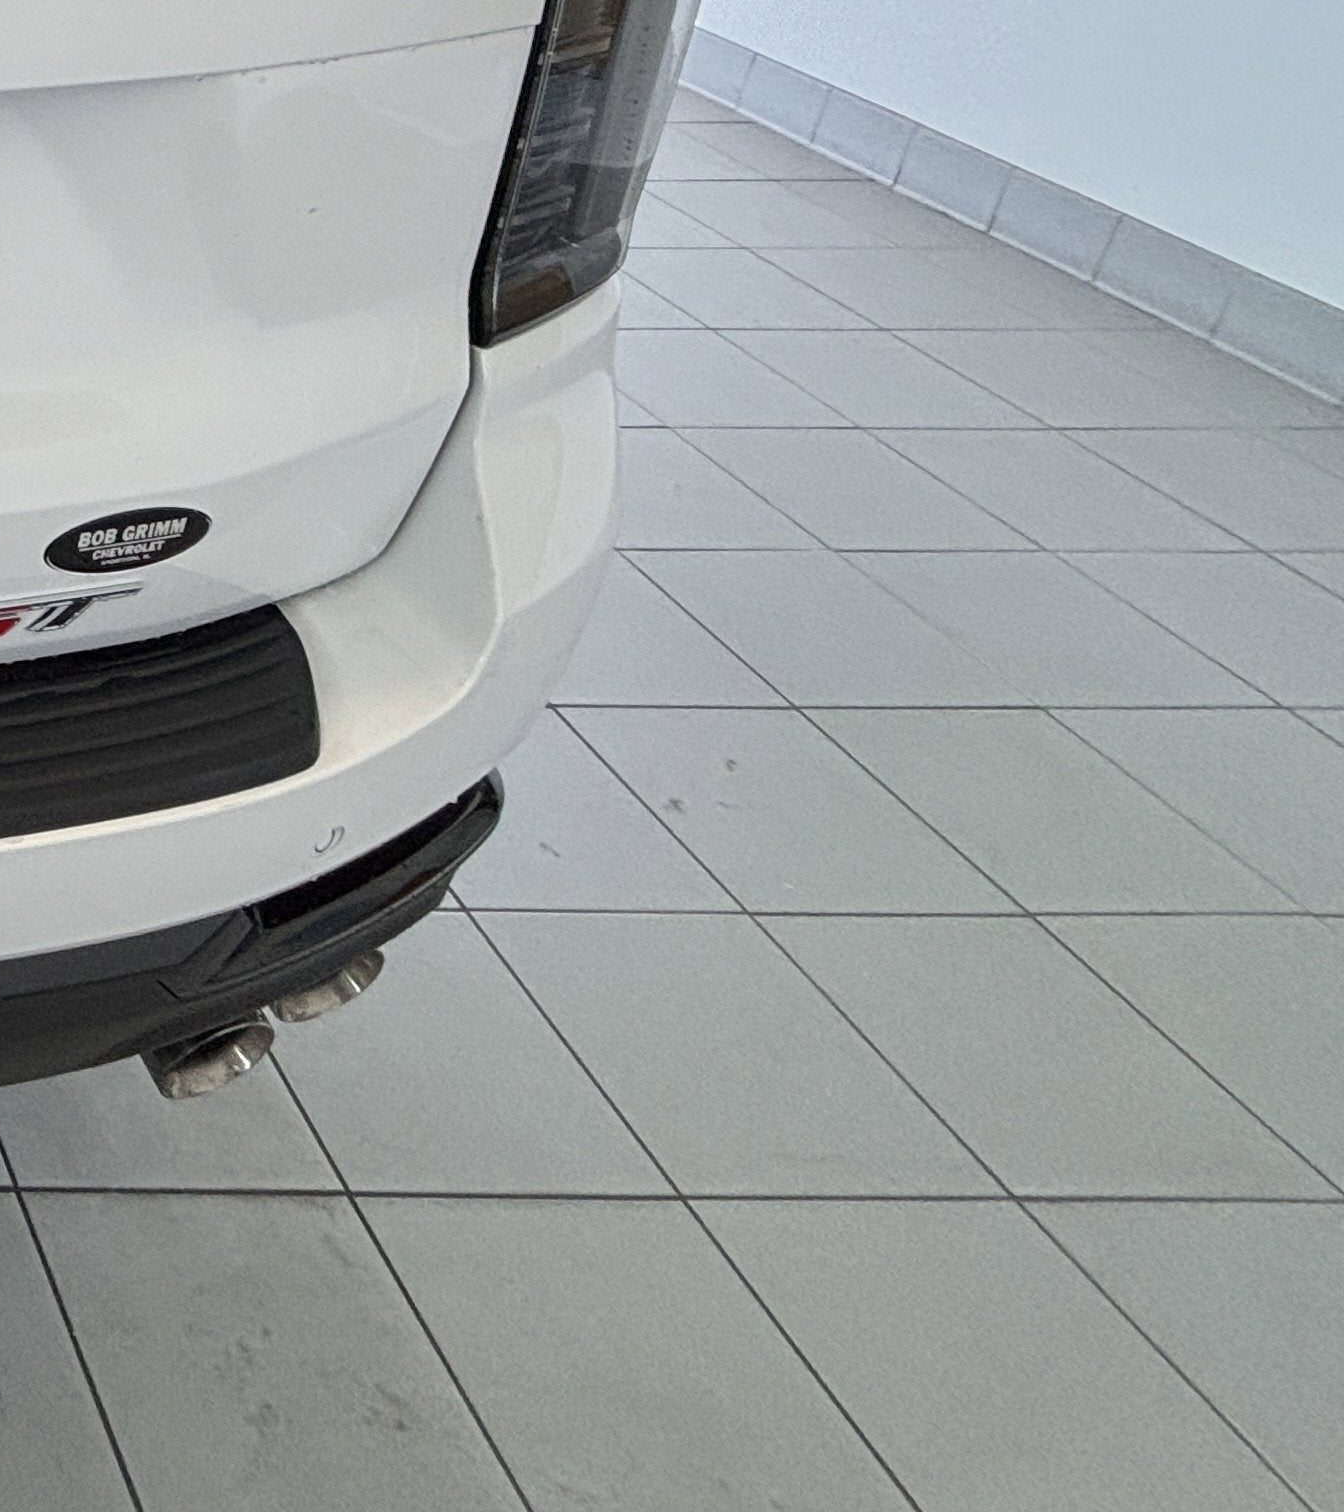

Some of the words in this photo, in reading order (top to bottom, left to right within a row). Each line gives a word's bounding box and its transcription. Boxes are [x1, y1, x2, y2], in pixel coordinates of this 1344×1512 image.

[78, 529, 117, 548] BOB
[123, 518, 188, 541] GRIMM
[92, 541, 165, 560] CHEVROLET
